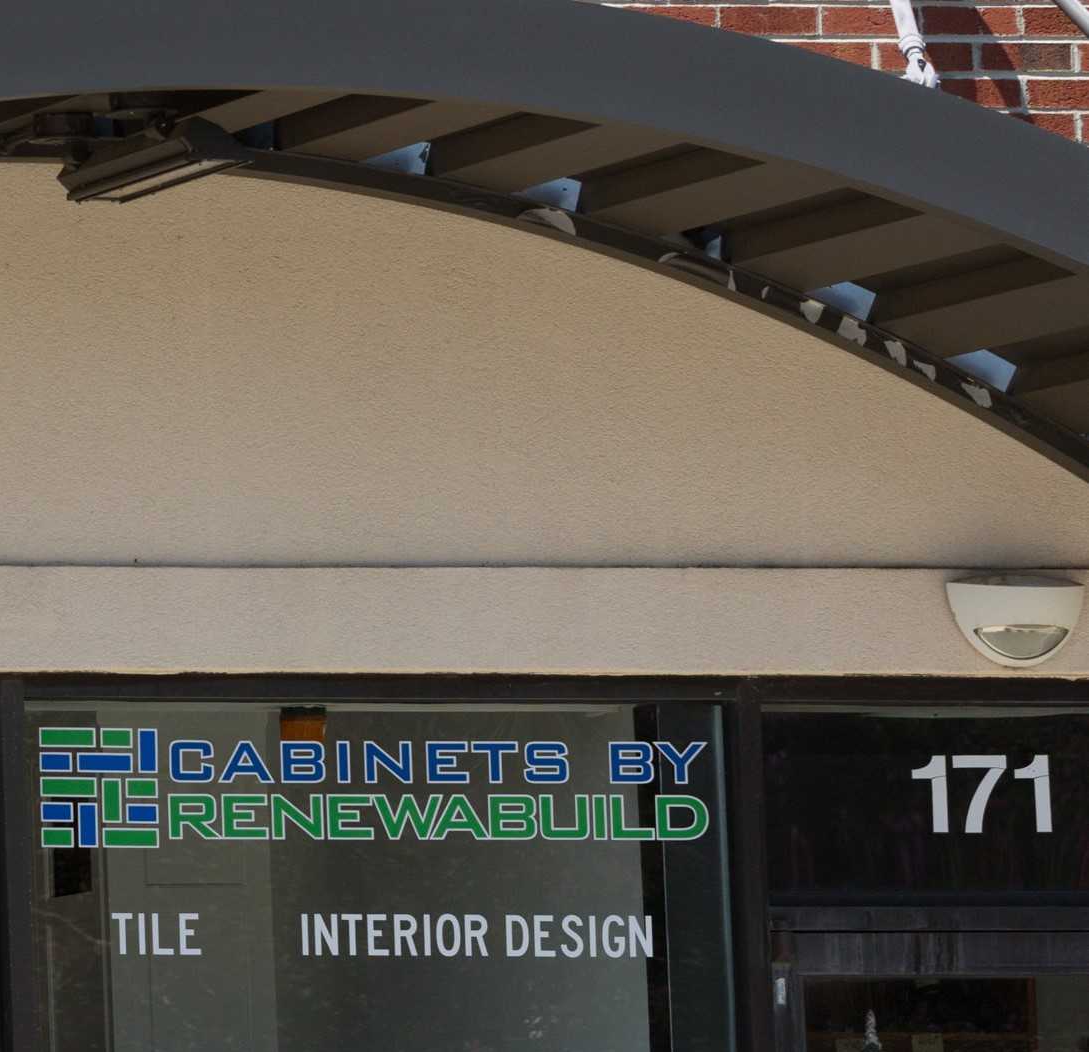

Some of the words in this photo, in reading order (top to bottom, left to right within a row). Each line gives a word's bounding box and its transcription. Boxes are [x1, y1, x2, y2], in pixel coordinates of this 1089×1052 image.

[168, 740, 569, 784] CABINETS
[608, 741, 708, 784] BY
[167, 793, 710, 841] RENEWABUILD
[911, 755, 1053, 833] 171
[111, 912, 202, 956] TILE
[301, 913, 489, 957] INTERIOR
[505, 914, 653, 959] DESIGN
